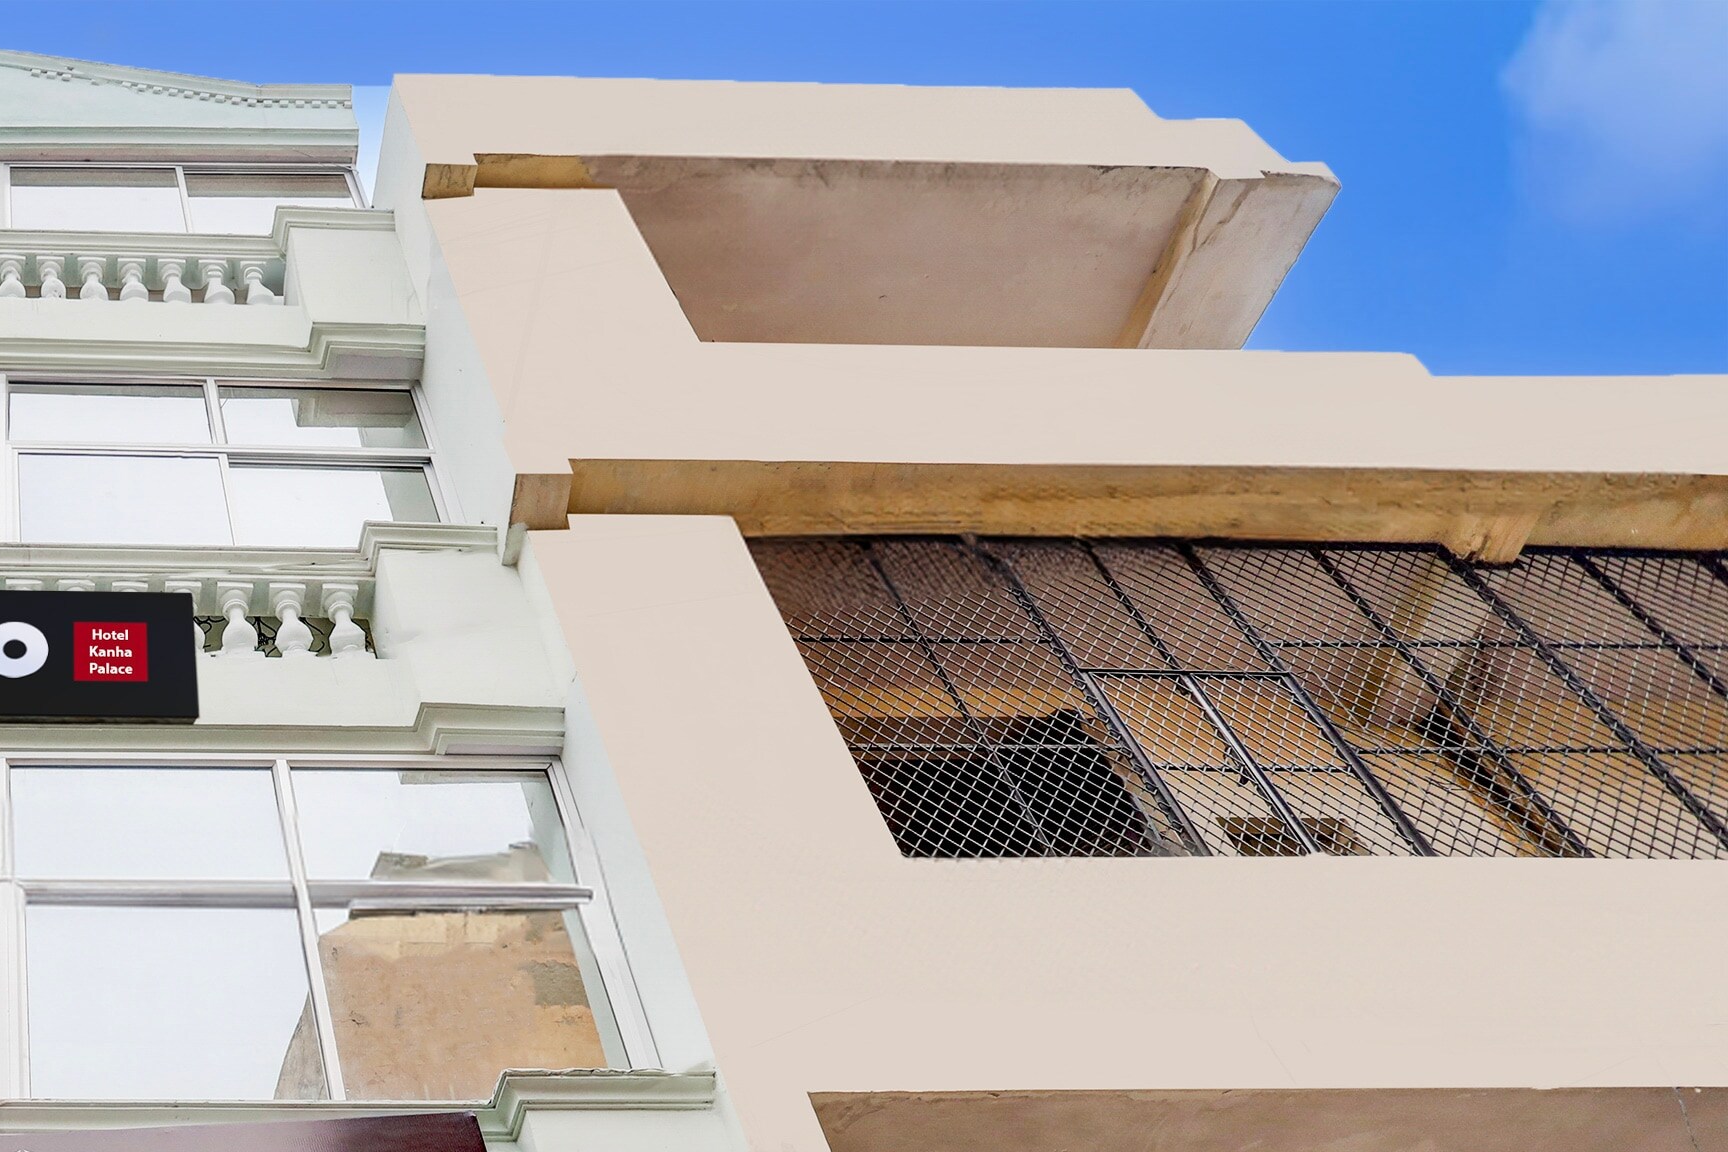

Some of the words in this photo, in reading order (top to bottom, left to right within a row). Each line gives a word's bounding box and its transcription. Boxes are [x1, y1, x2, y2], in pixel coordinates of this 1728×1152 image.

[92, 628, 129, 640] Hotel
[89, 645, 133, 657] Kanha
[89, 662, 133, 674] Palace
